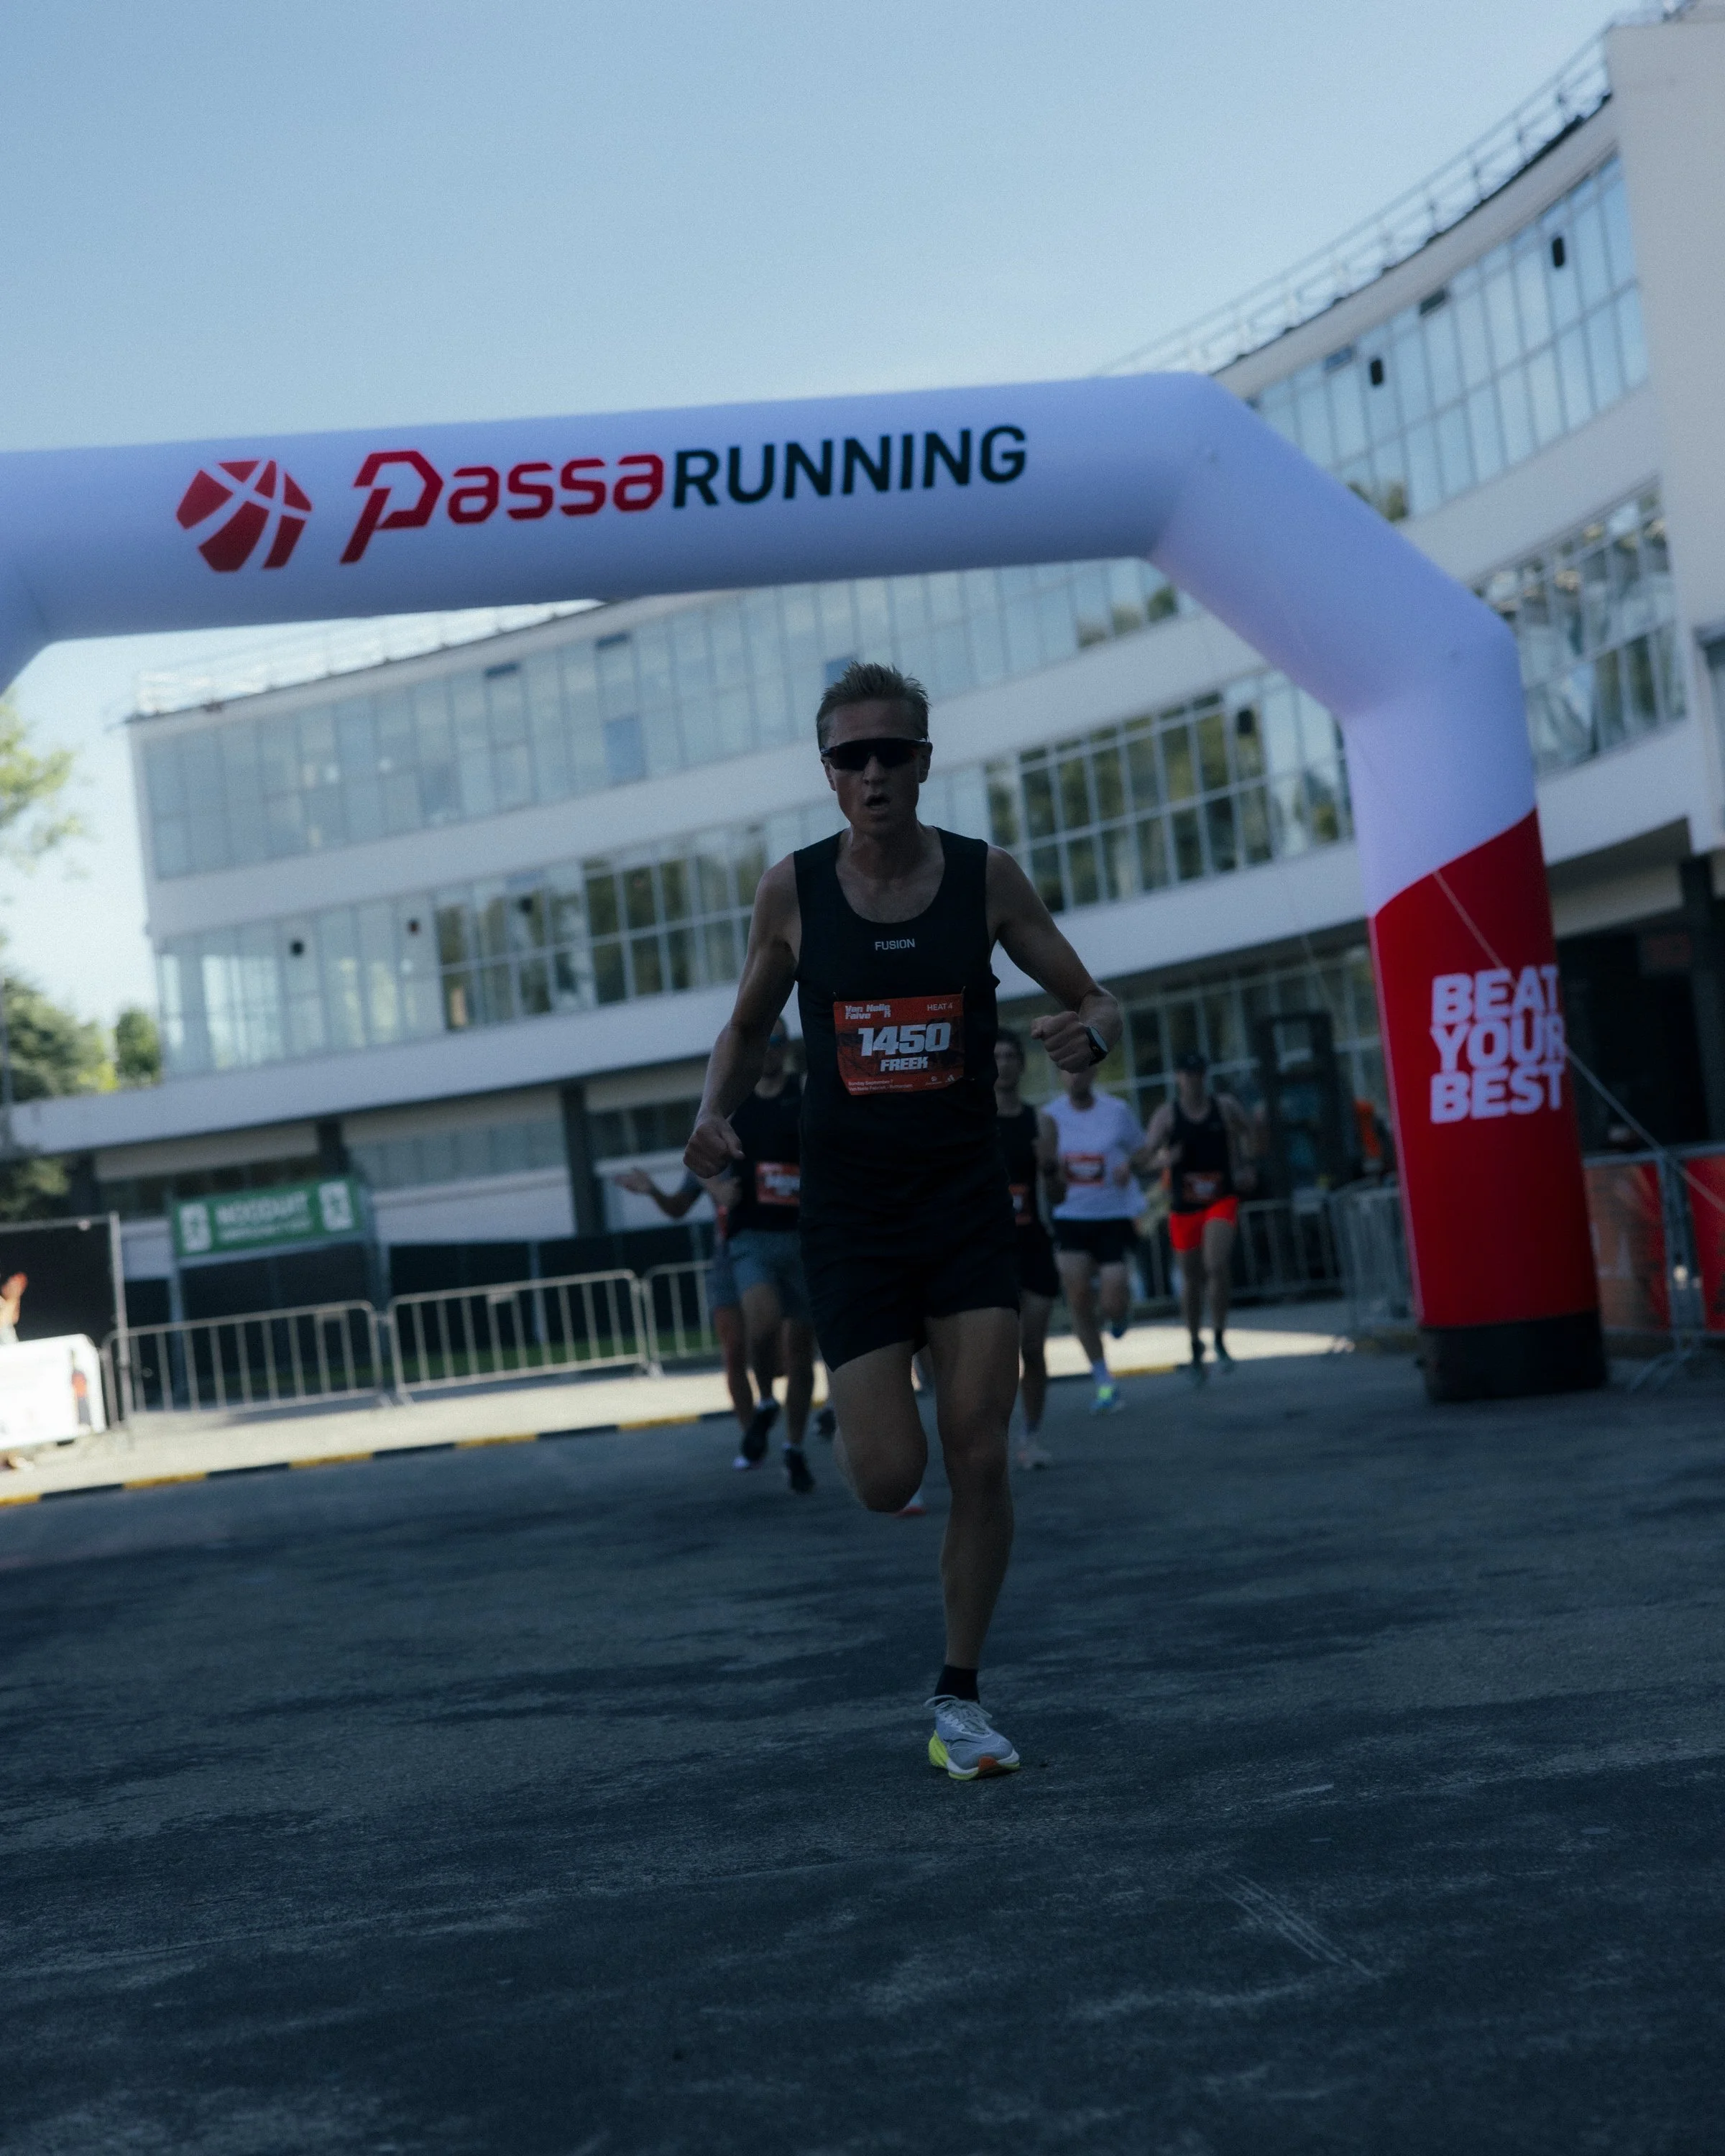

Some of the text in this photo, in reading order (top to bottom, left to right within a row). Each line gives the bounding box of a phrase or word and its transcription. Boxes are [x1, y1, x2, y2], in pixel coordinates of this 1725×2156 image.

[875, 938, 915, 951] FUSION
[1432, 964, 1558, 1023] BEAT
[857, 1022, 951, 1056] 1450
[1430, 1013, 1565, 1072] YOUR
[880, 1056, 929, 1072] FREEK
[1430, 1063, 1565, 1124] BEST
